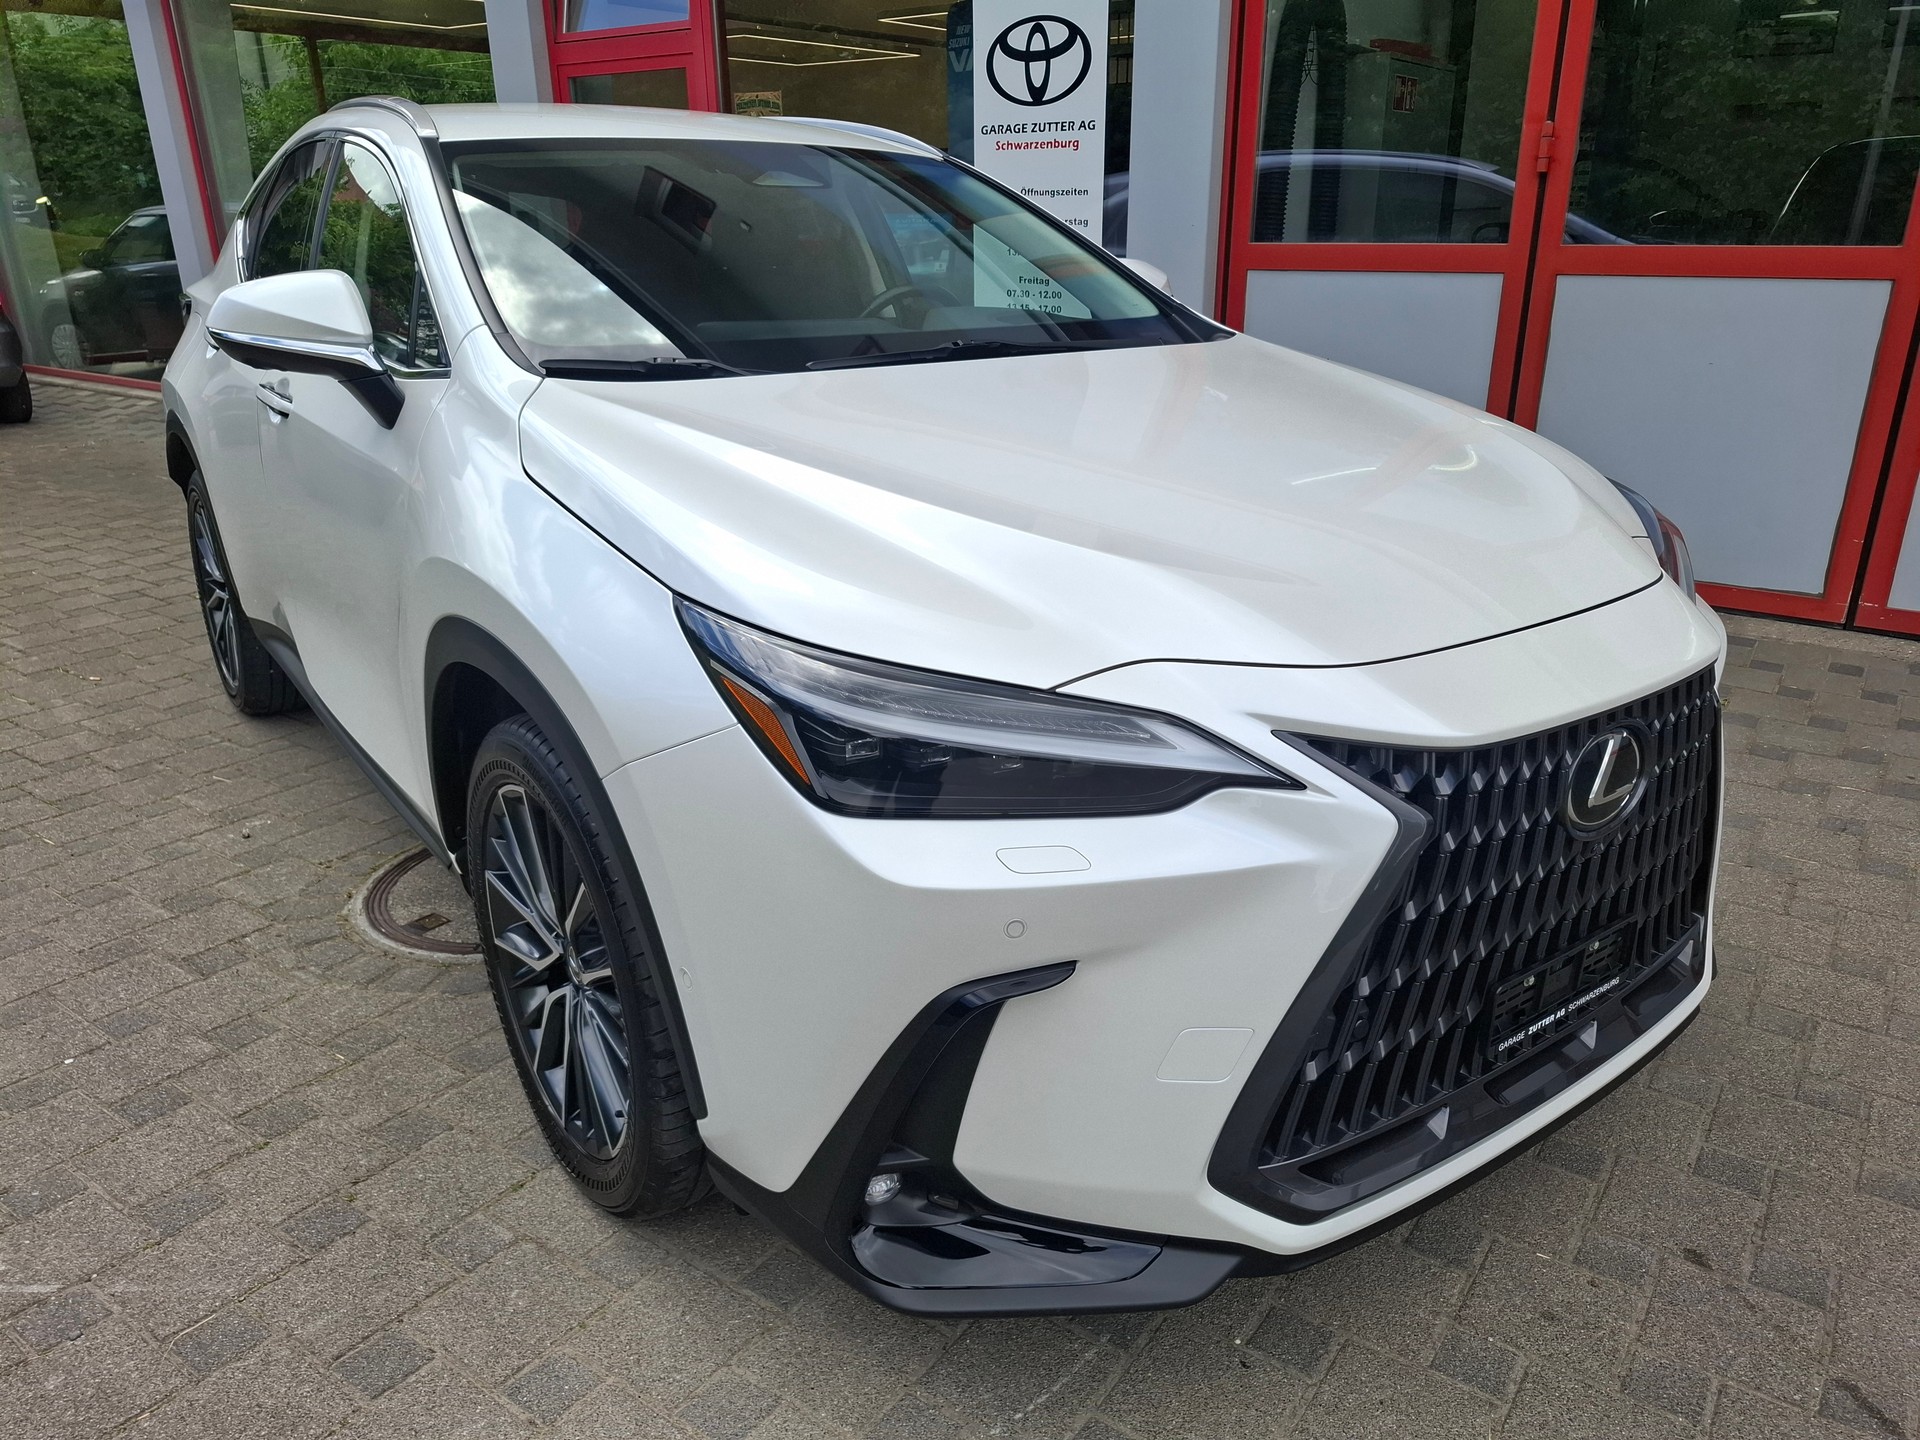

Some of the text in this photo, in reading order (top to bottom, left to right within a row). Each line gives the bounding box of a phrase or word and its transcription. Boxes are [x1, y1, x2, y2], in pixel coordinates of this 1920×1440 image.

[948, 37, 970, 48] SUZUKI
[981, 120, 1096, 135] GARAGE ZUTTER AG
[995, 139, 1080, 152] Schwarzenburg
[1020, 186, 1089, 198] Öffnungszeiten
[1019, 276, 1050, 287] Freitag
[1006, 289, 1030, 298] 07.30
[1038, 290, 1062, 300] 12.00
[1498, 976, 1620, 1052] GARAGE ZUTTER AG SCHWARZENBURG
